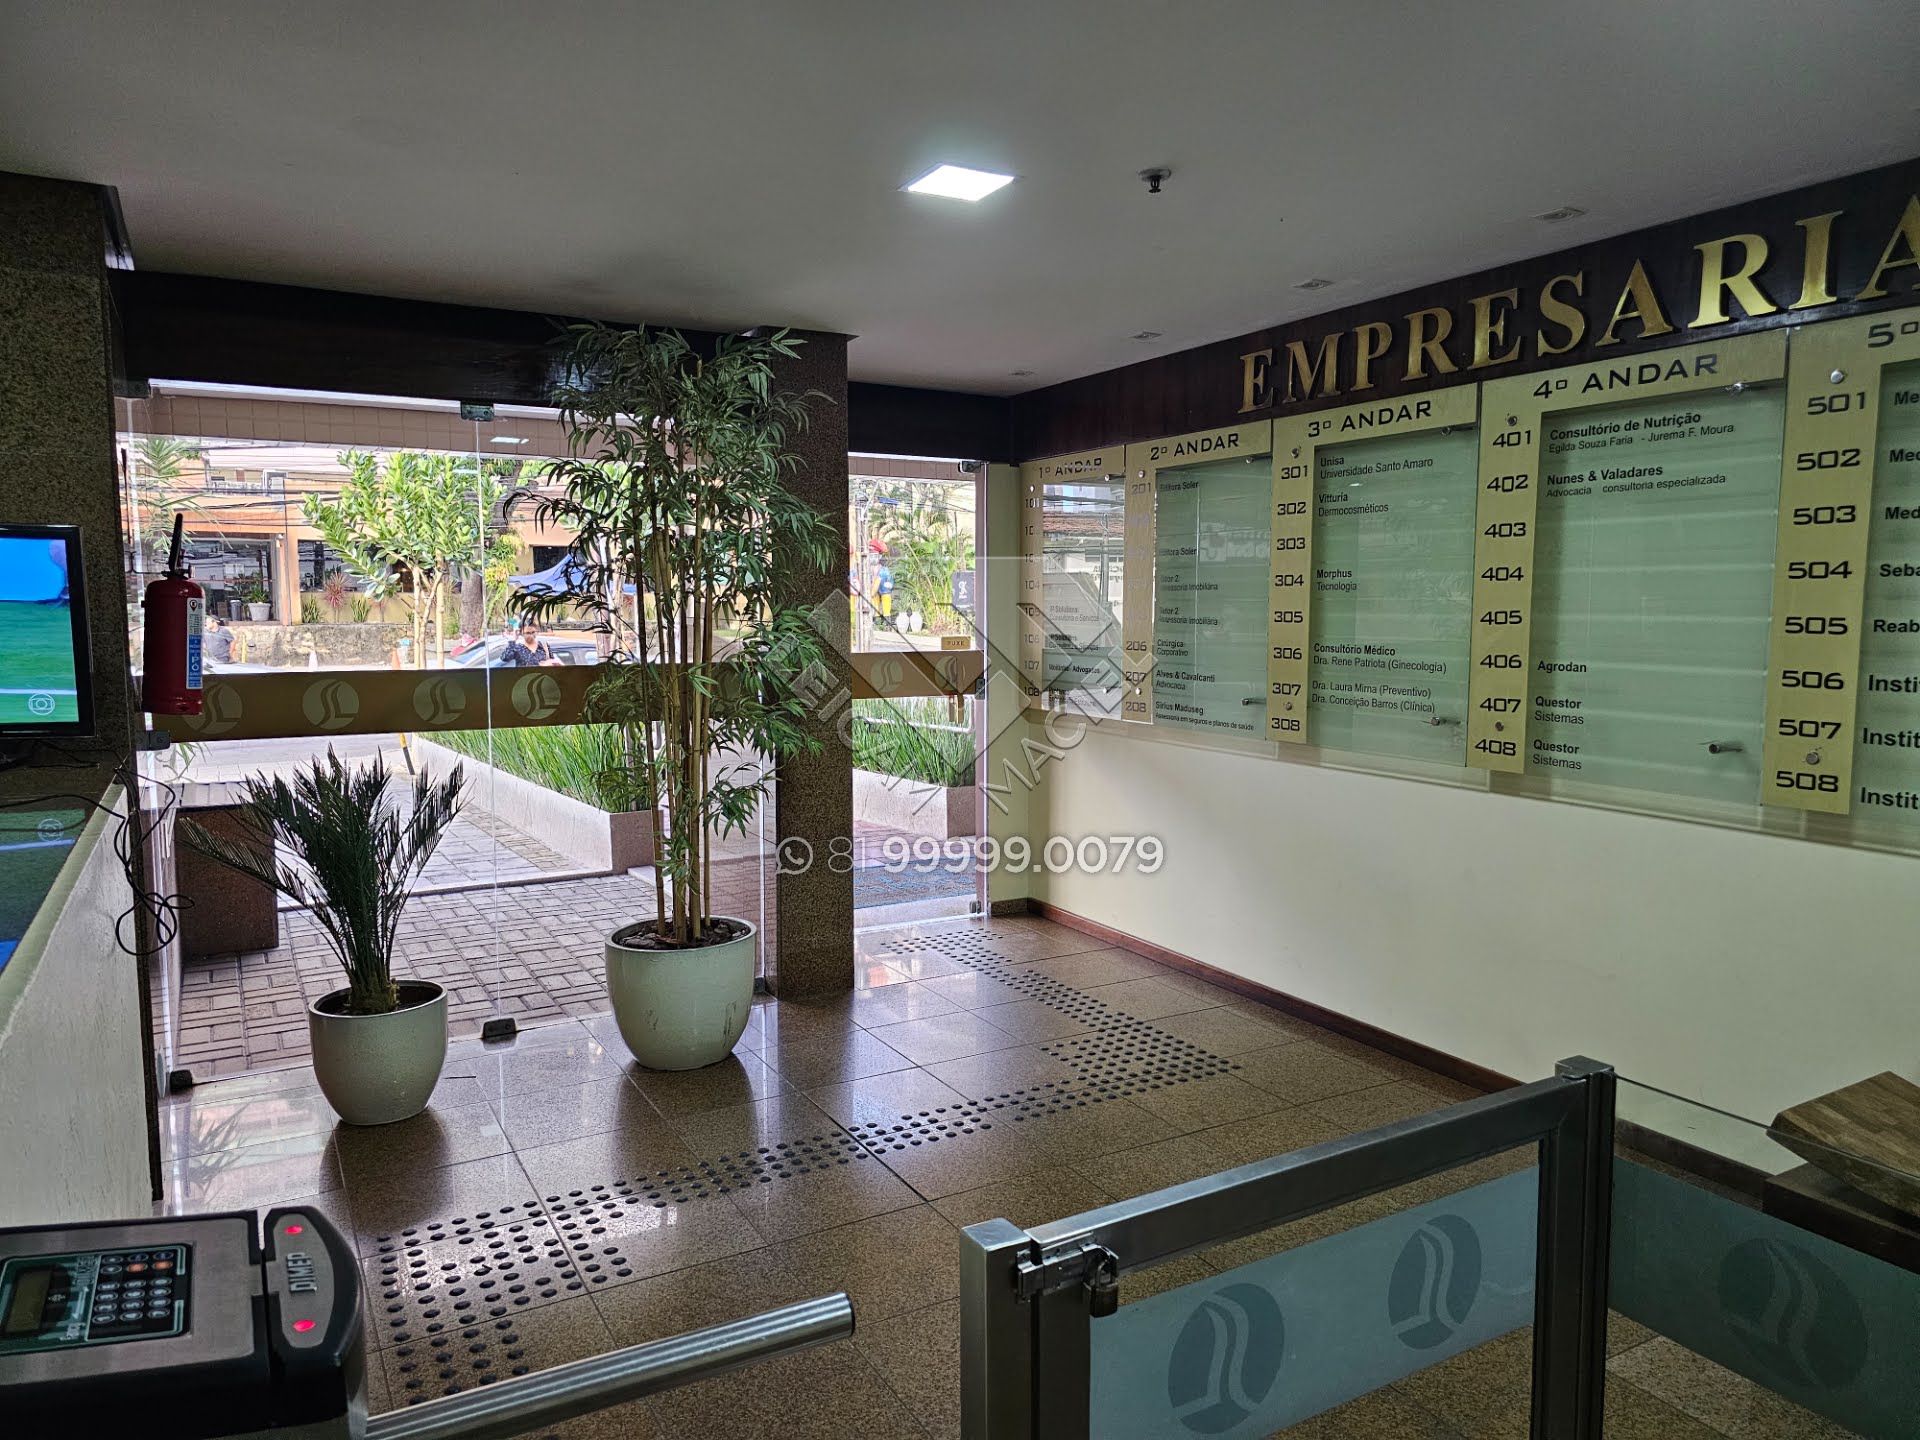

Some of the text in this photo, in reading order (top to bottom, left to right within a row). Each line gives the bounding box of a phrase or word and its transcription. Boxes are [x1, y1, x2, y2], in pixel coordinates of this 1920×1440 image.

[1581, 353, 1719, 394] ANDAR
[1807, 391, 1866, 416] 501
[1340, 401, 1432, 433] ANDAR
[1550, 412, 1702, 441] Consultório de Nutrição
[1174, 433, 1239, 457] ANDAR
[1492, 430, 1533, 449] 401
[1549, 442, 1576, 454] Egilda
[1578, 439, 1607, 450] Souza
[1609, 436, 1633, 446] Faria
[1647, 430, 1685, 443] Jurema
[1688, 427, 1697, 437] F.
[1700, 424, 1735, 436] Moura
[1055, 457, 1102, 476] ANDAR
[1320, 457, 1345, 467] Unisa
[1796, 448, 1861, 471] 502
[1280, 465, 1309, 480] 301
[1320, 458, 1434, 480] Universidade Santo Amaro
[1547, 465, 1664, 486] Nunes & Valadares
[1132, 482, 1152, 495] 201
[1486, 474, 1529, 492] 402
[1546, 473, 1726, 498] Advocacia consultoria especializada
[1277, 500, 1307, 516] 302
[1318, 503, 1389, 517] Dermocosméticos
[1793, 505, 1857, 525] 503
[1484, 522, 1527, 539] 403
[1276, 536, 1306, 551] 303
[1316, 568, 1352, 581] Morphus
[1481, 567, 1524, 582] 404
[1787, 561, 1853, 580] 504
[1024, 580, 1040, 590] 104
[1274, 574, 1305, 587] 304
[1316, 581, 1357, 593] Tecnologia
[1273, 611, 1304, 624] 305
[1479, 610, 1523, 626] 405
[1784, 616, 1849, 635] 505
[1024, 634, 1039, 643] 106
[1126, 640, 1147, 652] 206
[1273, 647, 1303, 661] 306
[1313, 642, 1396, 656] Consultório Médico
[1023, 660, 1039, 671] 107
[1313, 655, 1447, 675] Dra. Rene Patriota (Ginecologia)
[1479, 654, 1522, 670] 406
[1537, 660, 1587, 674] Agrodan
[1125, 671, 1147, 683] 207
[1156, 670, 1216, 683] Alves & Cavalcanti
[1781, 670, 1845, 690] 506
[1868, 674, 1920, 693] Insti
[1022, 686, 1040, 697] 108
[1272, 683, 1302, 696] 307
[1312, 680, 1328, 690] Dra.
[1330, 681, 1353, 692] Laura
[1379, 684, 1432, 700] (Preventivo)
[1125, 701, 1147, 713] 208
[1155, 701, 1204, 716] Sirius Maduseg
[1311, 694, 1436, 714] Dra. Conceição Barros (Clínica)
[1479, 698, 1522, 713] 407
[1535, 696, 1582, 709] Questor
[1212, 719, 1230, 728] planos
[1271, 718, 1301, 732] 308
[1534, 710, 1584, 725] Sistemas
[1778, 718, 1842, 740] 507
[1863, 727, 1920, 749] Instit
[1474, 739, 1517, 757] 408
[1533, 739, 1580, 754] Questor
[1532, 753, 1582, 770] Sistemas
[1775, 770, 1840, 793] 508
[1860, 786, 1919, 810] Instit
[287, 1252, 317, 1292] DIMEP
